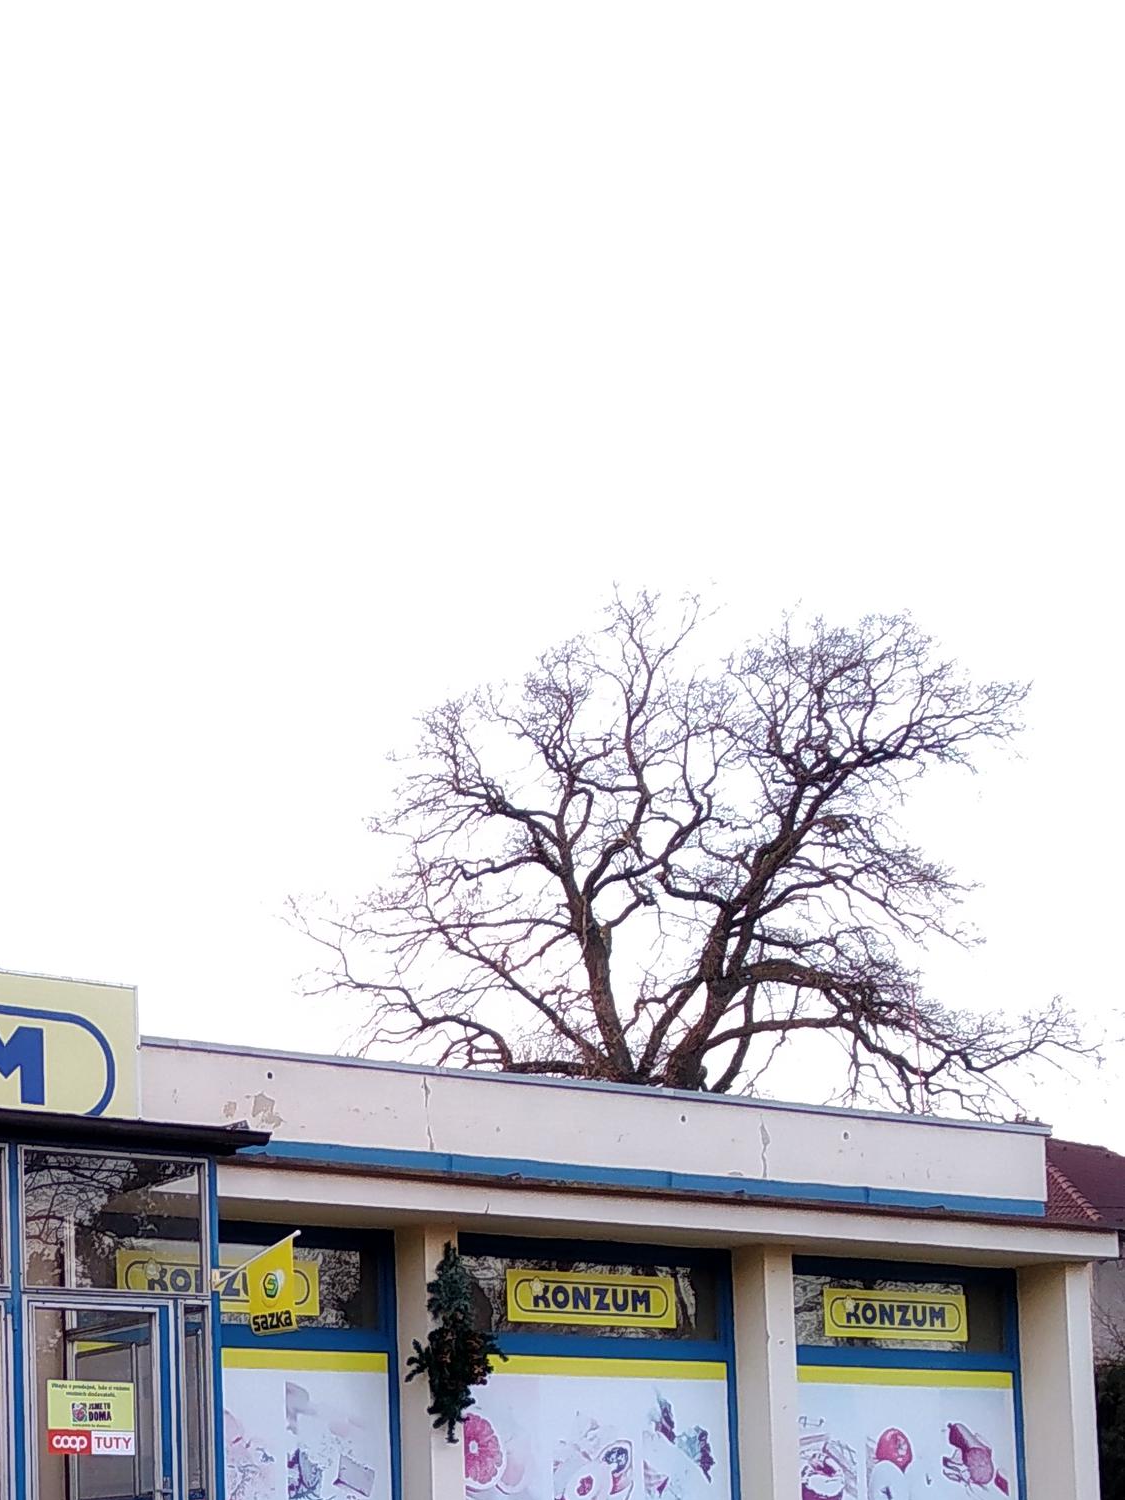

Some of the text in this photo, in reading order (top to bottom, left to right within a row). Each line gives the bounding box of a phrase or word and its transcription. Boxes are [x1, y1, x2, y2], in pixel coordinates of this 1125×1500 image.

[532, 1284, 651, 1313] KONZUM
[845, 1302, 946, 1328] KONZUM
[88, 1411, 112, 1421] DOMA
[52, 1435, 87, 1452] coop
[94, 1437, 131, 1449] TUTY
